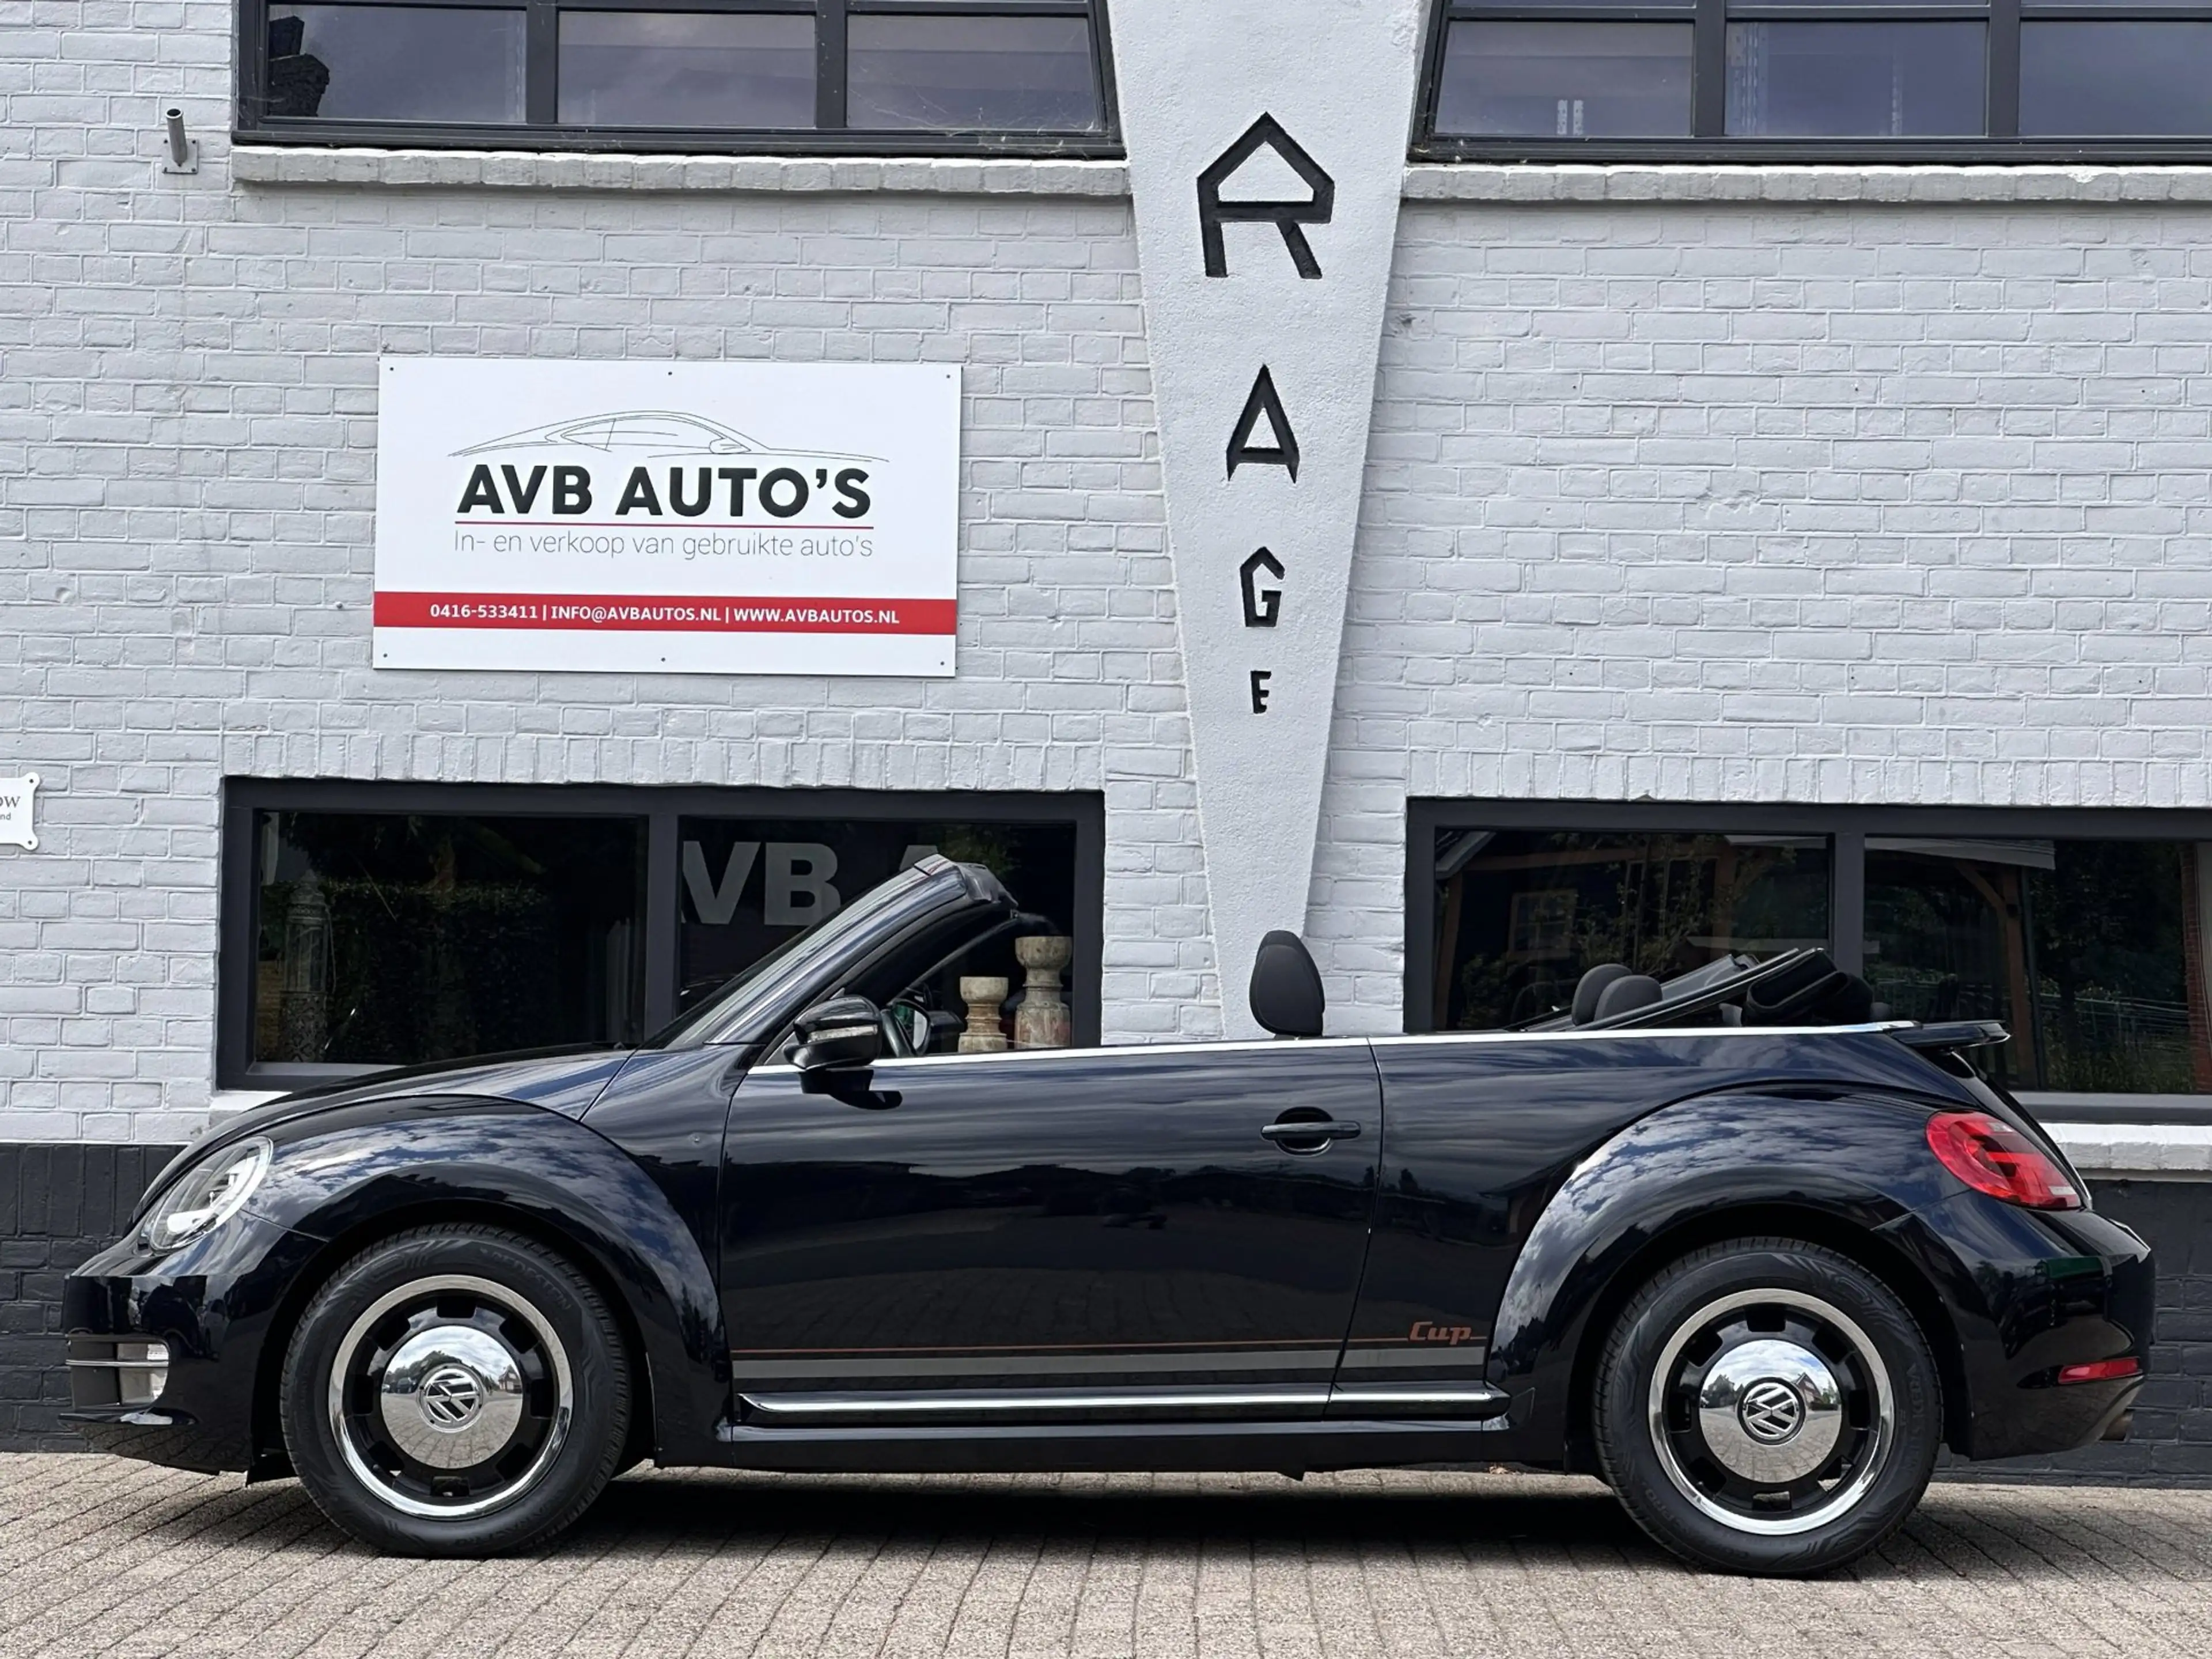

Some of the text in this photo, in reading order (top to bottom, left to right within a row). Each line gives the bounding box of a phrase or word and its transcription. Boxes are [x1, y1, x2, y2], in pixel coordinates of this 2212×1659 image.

[456, 464, 871, 518] AVB AUTO'S
[454, 529, 873, 560] In- en verkoop van gebruikte auto's
[430, 604, 900, 624] 0416-533411 INFO@AVBAUTOS.NL WWW.AVBAUTOS.NL
[681, 840, 841, 926] VB
[1410, 1321, 1472, 1345] Cup
